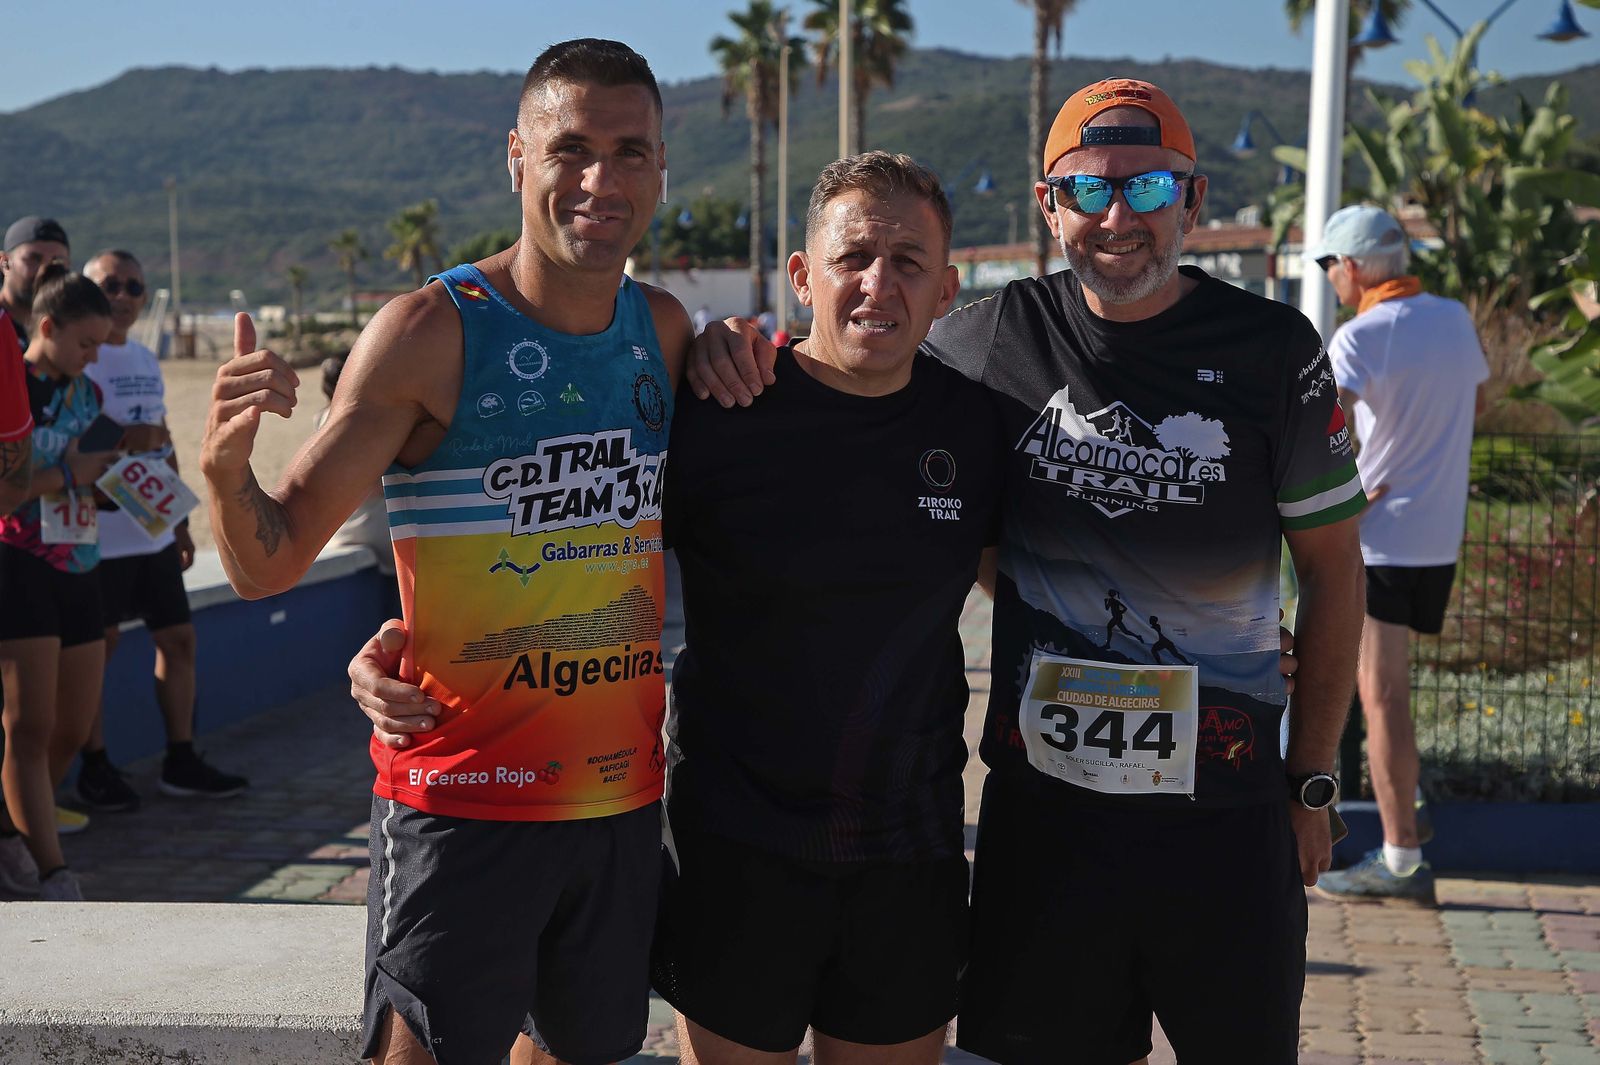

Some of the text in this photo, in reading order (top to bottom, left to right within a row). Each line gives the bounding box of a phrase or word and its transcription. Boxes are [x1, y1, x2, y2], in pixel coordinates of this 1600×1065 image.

[542, 436, 631, 484] TRAIL
[121, 461, 177, 516] 139
[1037, 461, 1198, 503] TRAIL
[517, 482, 615, 527] TEAM
[918, 496, 962, 510] ZIROKO
[1066, 489, 1159, 513] RUNNING
[929, 508, 960, 521] TRAIL
[541, 541, 619, 562] Gabarras
[622, 536, 632, 555] &
[1060, 666, 1081, 679] XXIII
[1056, 690, 1161, 710] CIUDAD DE ALGECIRAS
[1040, 703, 1177, 760] 344
[408, 766, 536, 788] El Cerezo Rojo
[1119, 761, 1146, 769] RAFAEL
